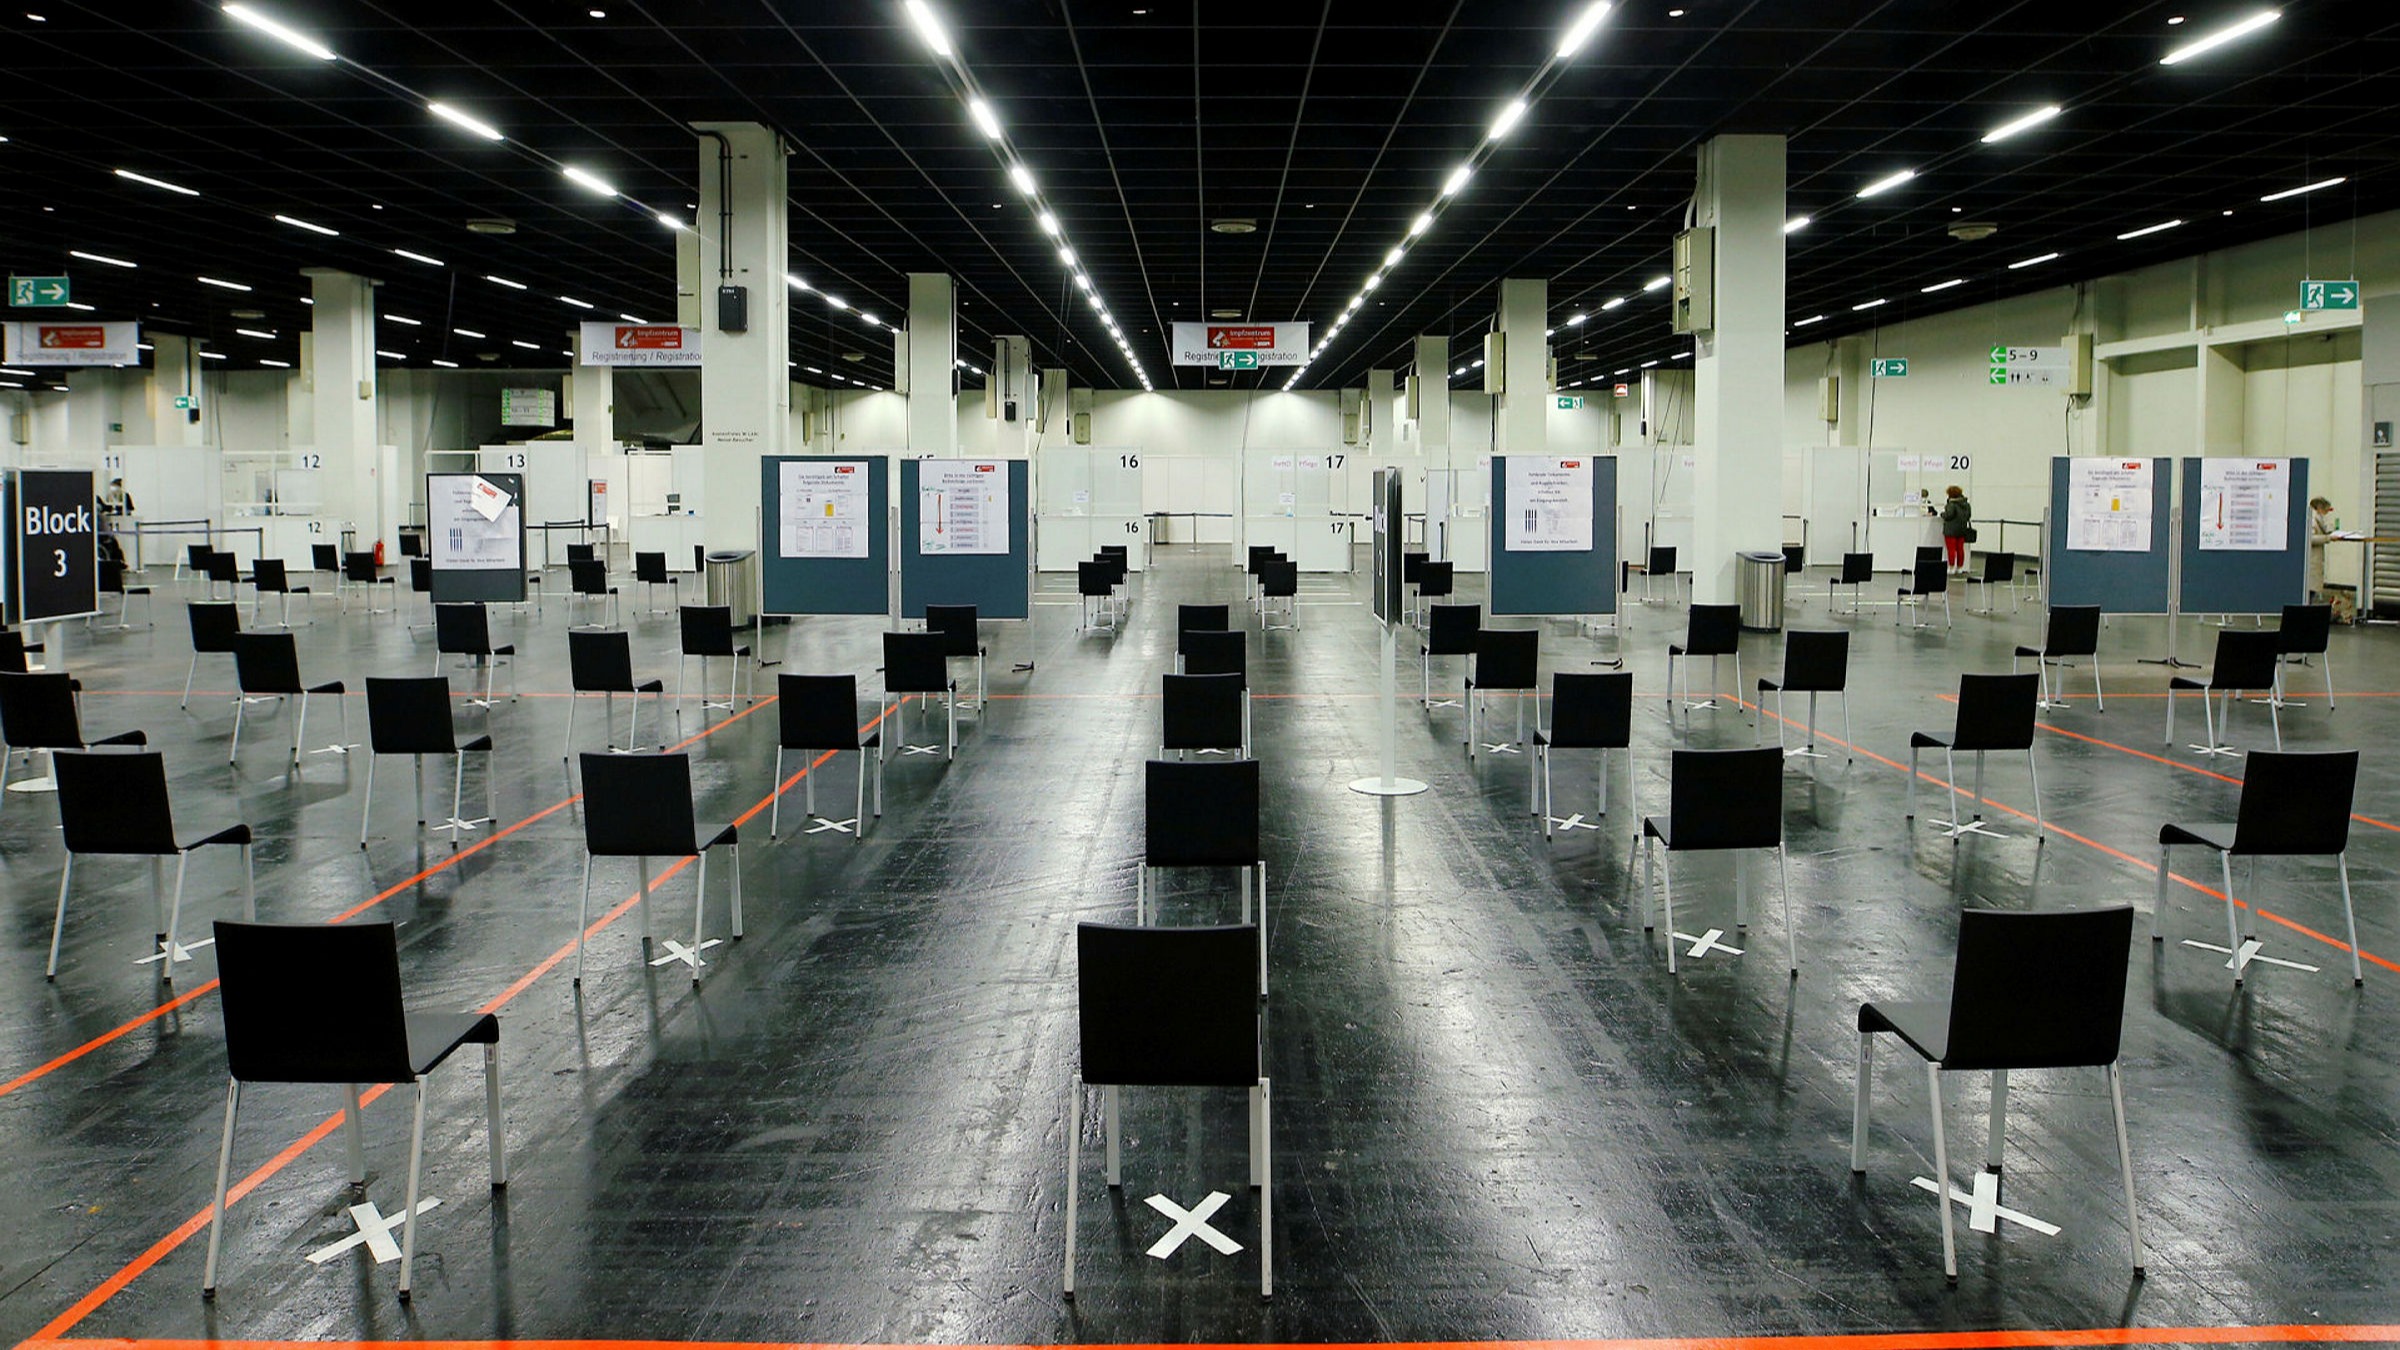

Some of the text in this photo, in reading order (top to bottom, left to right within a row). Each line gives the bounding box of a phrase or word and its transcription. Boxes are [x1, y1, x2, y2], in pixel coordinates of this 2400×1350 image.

[1229, 329, 1271, 338] Impfzentrum
[592, 351, 647, 362] Registrierung
[655, 351, 702, 362] Registratio
[2008, 349, 2018, 361] 5
[2029, 349, 2039, 361] 9
[106, 455, 119, 469] 11
[303, 454, 321, 469] 12
[508, 453, 525, 468] 13
[1120, 454, 1139, 469] 16
[1326, 454, 1345, 469] 17
[1950, 455, 1970, 470] 20
[25, 504, 92, 536] Block
[308, 521, 321, 534] 12
[1125, 521, 1139, 534] 16
[1330, 522, 1344, 534] 17
[53, 548, 68, 578] 3
